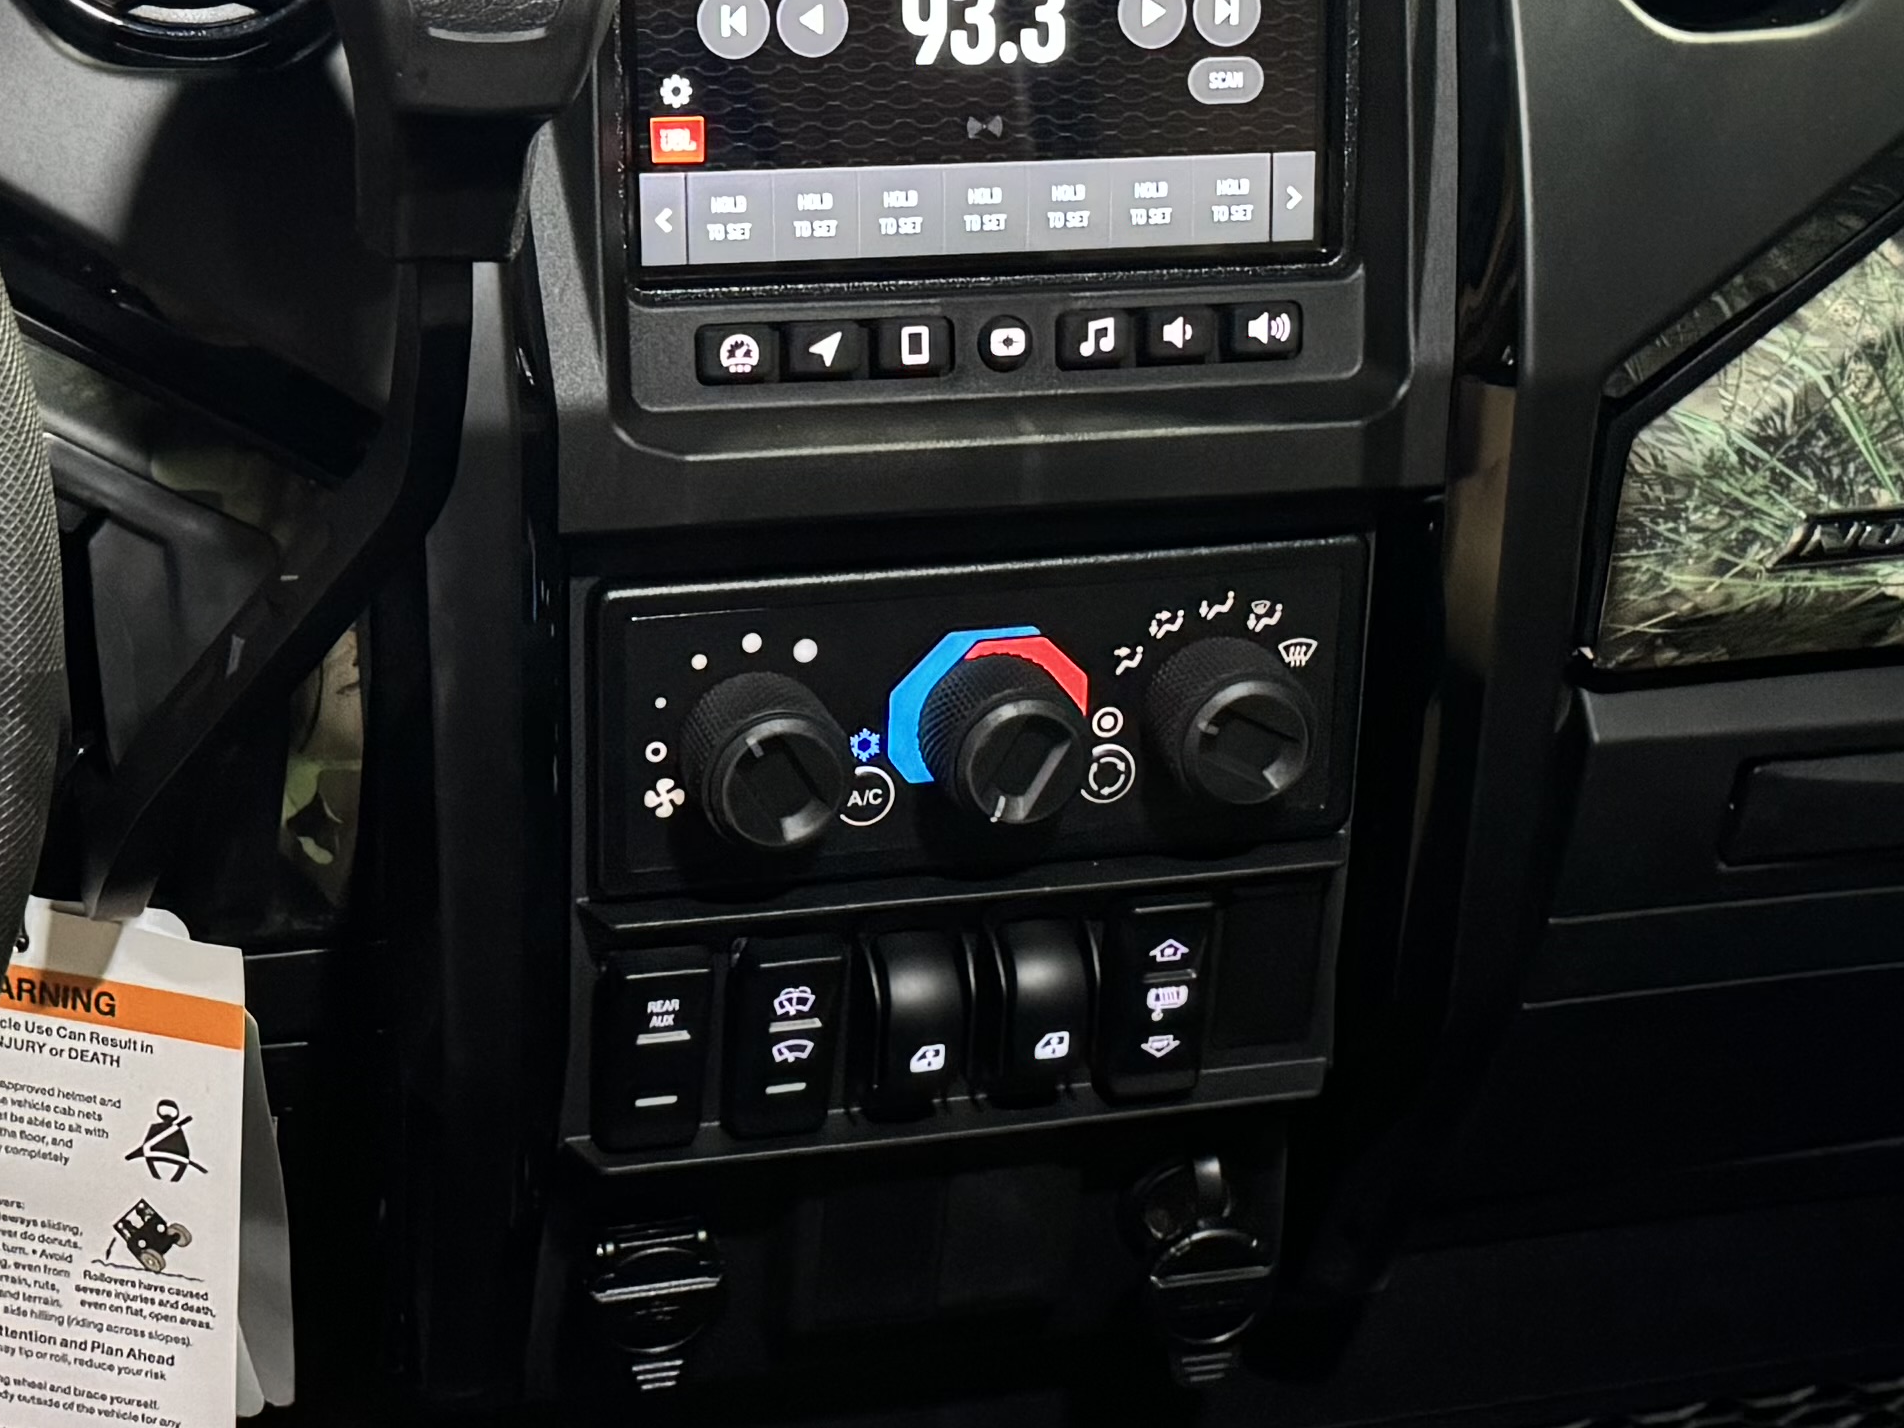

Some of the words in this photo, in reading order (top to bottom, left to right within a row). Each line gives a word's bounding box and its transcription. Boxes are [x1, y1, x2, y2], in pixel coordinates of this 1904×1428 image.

[1208, 71, 1244, 90] SCAN
[659, 128, 697, 152] JBL
[967, 187, 1003, 205] HOLD
[1051, 184, 1086, 202] HOLD
[1134, 181, 1169, 199] HOLD
[1216, 178, 1250, 196] HOLD
[710, 196, 747, 214] HOLD
[797, 193, 833, 211] HOLD
[882, 190, 919, 208] HOLD
[1047, 211, 1064, 228] TO
[1065, 210, 1090, 228] SET
[1130, 208, 1147, 225] TO
[1148, 207, 1172, 225] SET
[1212, 205, 1229, 222] TO
[1230, 204, 1254, 221] SET
[706, 224, 725, 241] TO
[727, 222, 752, 240] SET
[794, 220, 811, 238] TO
[813, 220, 838, 238] SET
[879, 217, 896, 235] TO
[898, 217, 923, 235] SET
[964, 214, 981, 232] TO
[982, 213, 1007, 231] SET
[847, 788, 883, 807] A/C
[0, 976, 116, 1017] ARNING
[647, 998, 680, 1013] REAR
[649, 1014, 675, 1028] AUX
[25, 1021, 52, 1036] Use
[57, 1026, 85, 1041] Can
[90, 1032, 137, 1051] Result
[141, 1041, 153, 1054] in
[49, 1048, 65, 1057] or
[69, 1047, 120, 1067] DEATH
[0, 1080, 55, 1097] approved
[60, 1338, 87, 1351] and
[91, 1341, 123, 1357] Plan
[127, 1348, 175, 1366] Ahead
